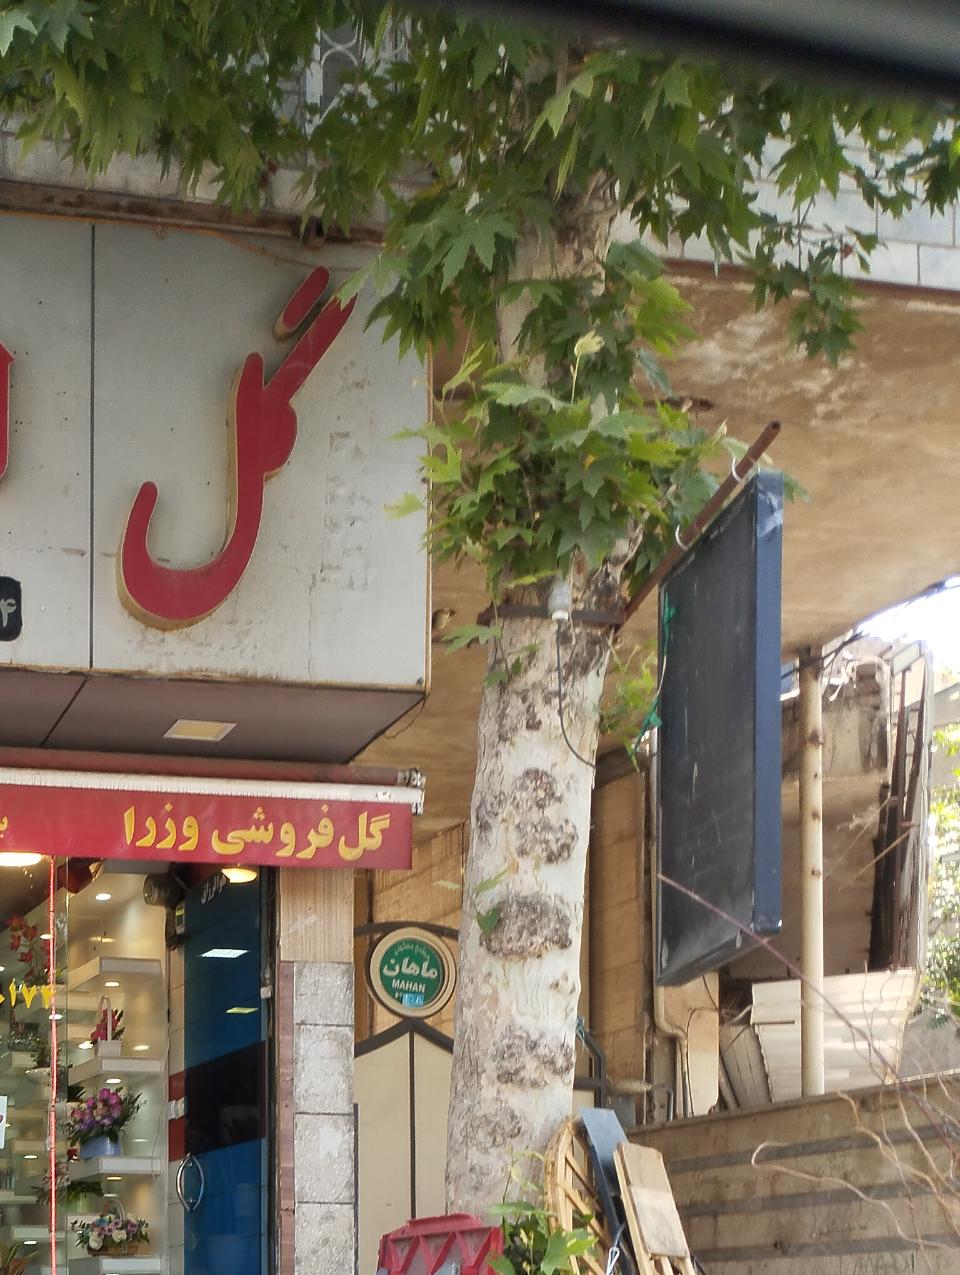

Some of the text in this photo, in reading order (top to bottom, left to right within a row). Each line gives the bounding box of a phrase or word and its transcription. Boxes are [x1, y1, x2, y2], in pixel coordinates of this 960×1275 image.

[115, 265, 358, 632] گل
[123, 802, 390, 861] گل فروشی وزرا
[382, 956, 438, 980] ماهان
[392, 977, 426, 994] MAHAN
